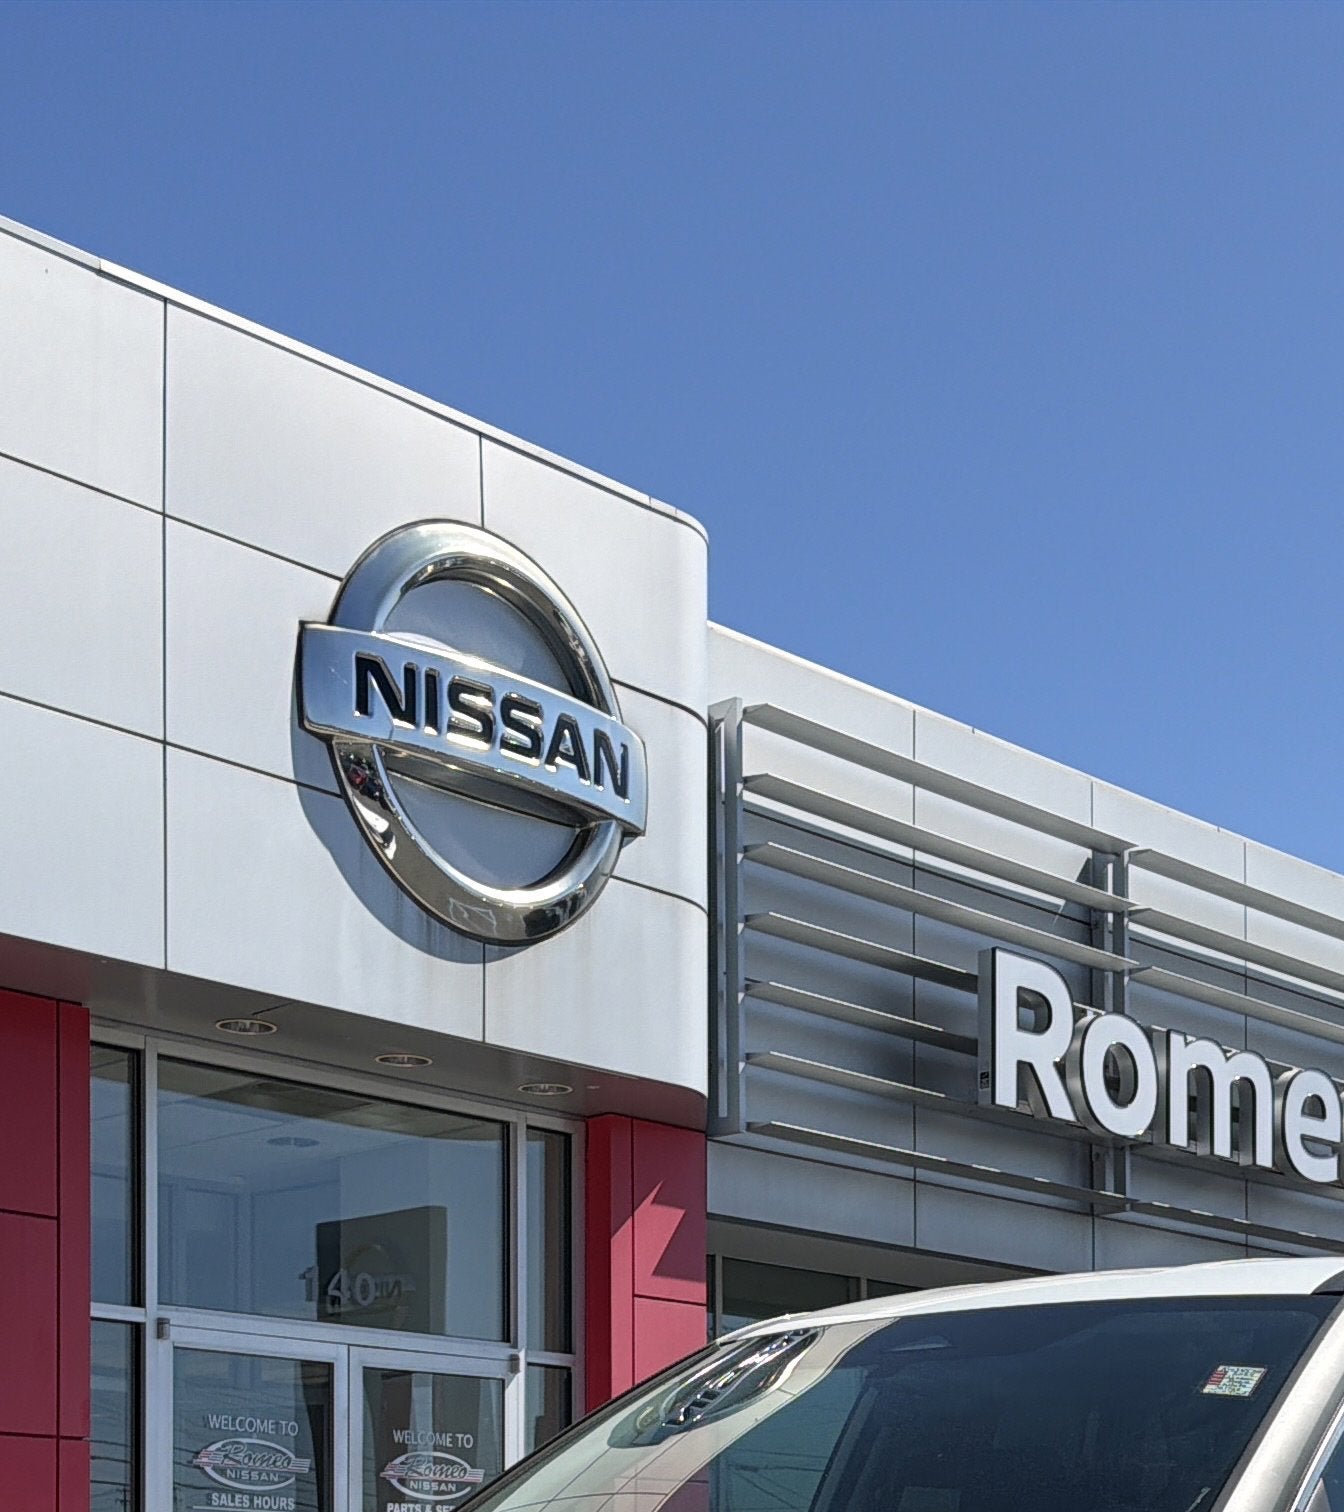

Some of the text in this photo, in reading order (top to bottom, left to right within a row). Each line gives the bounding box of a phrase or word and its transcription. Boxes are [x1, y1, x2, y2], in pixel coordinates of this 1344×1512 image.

[353, 651, 631, 804] NISSAN
[208, 1414, 299, 1437] WELCOME TO
[392, 1429, 474, 1449] WELCOME TO
[220, 1440, 294, 1468] Romeo
[226, 1469, 279, 1482] NISSAN
[404, 1454, 468, 1479] Romeo
[409, 1480, 456, 1492] NISSAN
[211, 1492, 296, 1511] SALES HOURS
